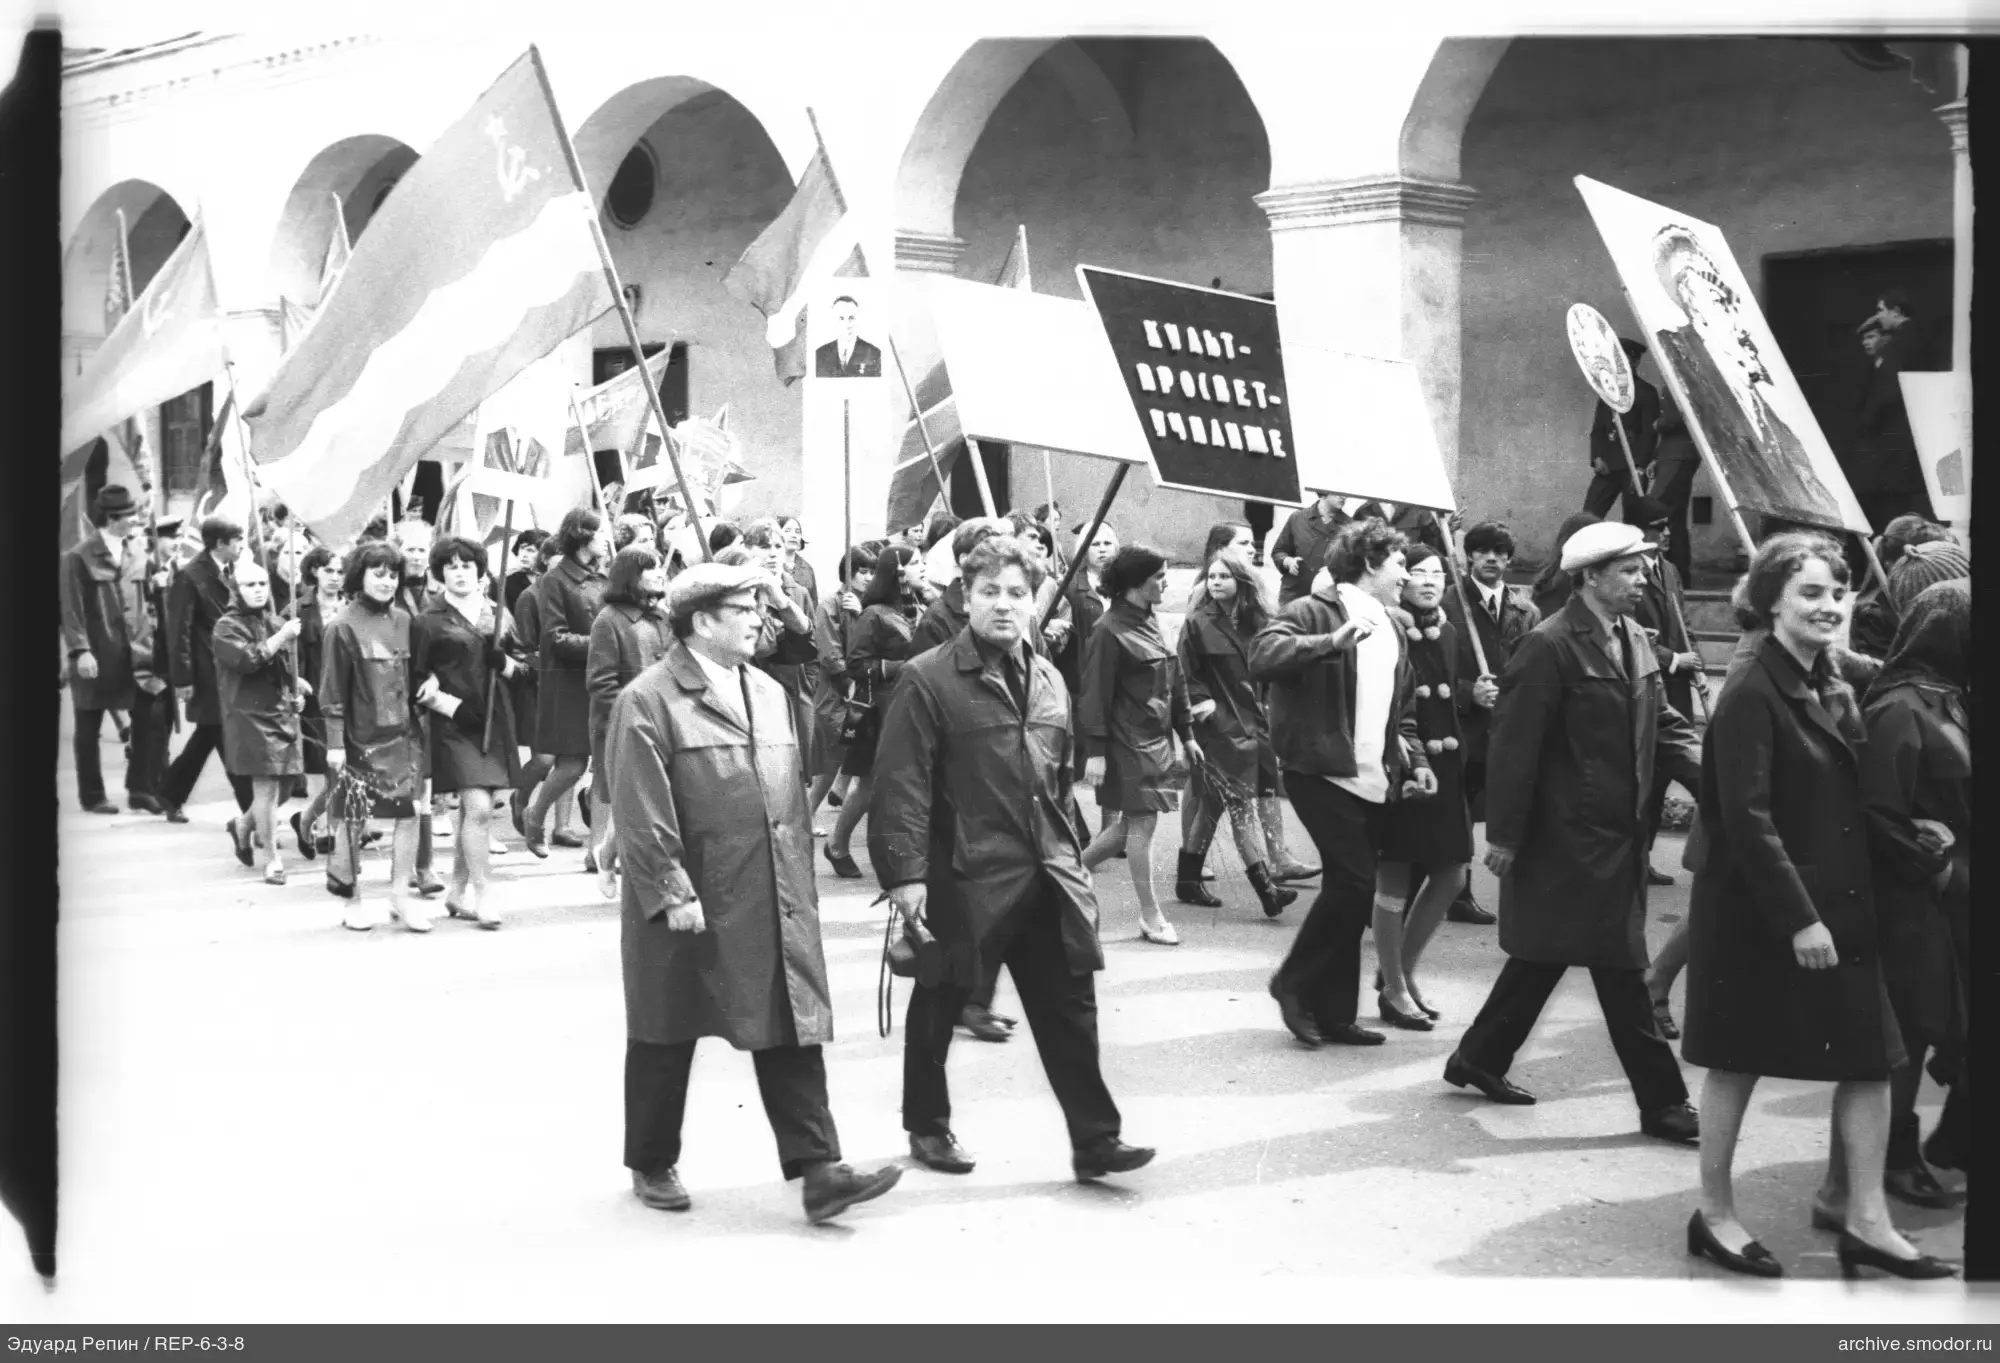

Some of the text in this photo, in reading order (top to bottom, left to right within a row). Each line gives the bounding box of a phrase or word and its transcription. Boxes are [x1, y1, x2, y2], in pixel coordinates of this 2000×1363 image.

[1143, 319, 1251, 359] КУЛЬТ-
[1136, 363, 1281, 409] ПРОСВЕТ-
[1149, 408, 1286, 458] УЧИЛИЩЕ
